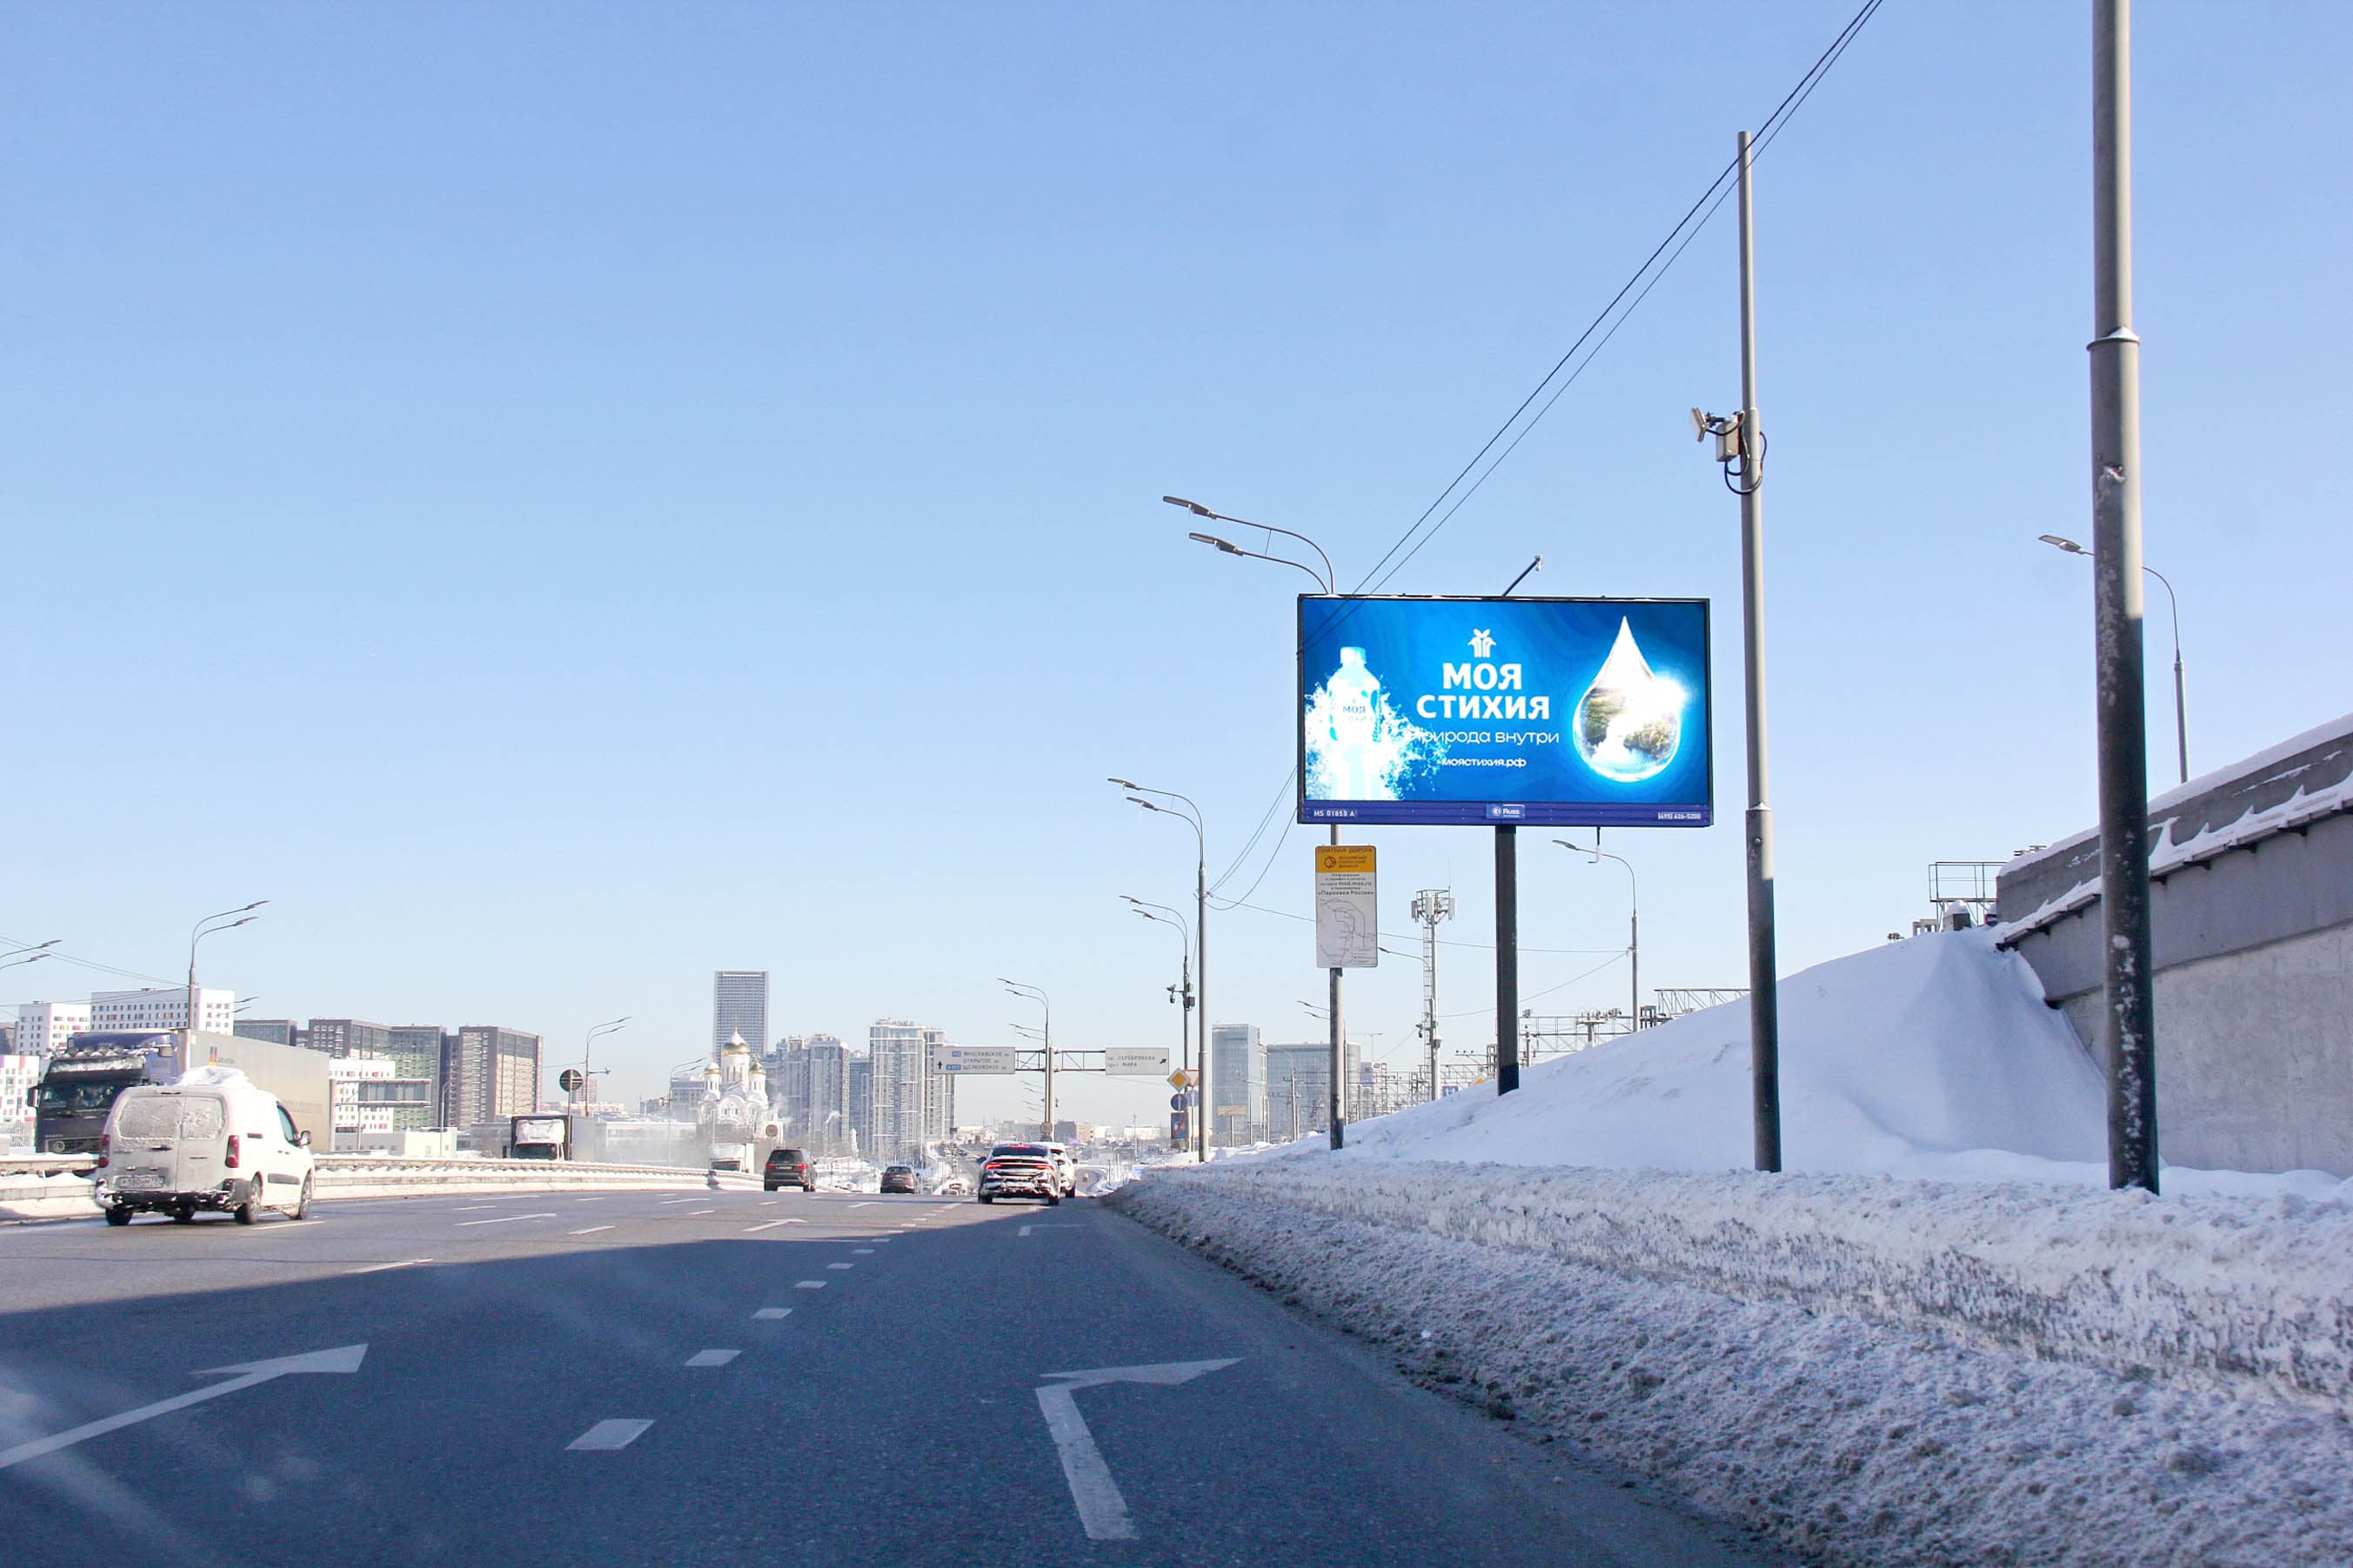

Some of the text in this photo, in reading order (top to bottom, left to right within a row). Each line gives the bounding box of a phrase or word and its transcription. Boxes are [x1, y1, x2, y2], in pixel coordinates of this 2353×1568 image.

[1442, 663, 1522, 690] МОЯ
[1342, 705, 1366, 714] МОЯ
[1416, 695, 1550, 720] СТИХИЯ
[1494, 731, 1560, 745] внутри
[1441, 757, 1527, 769] моястихия.рф
